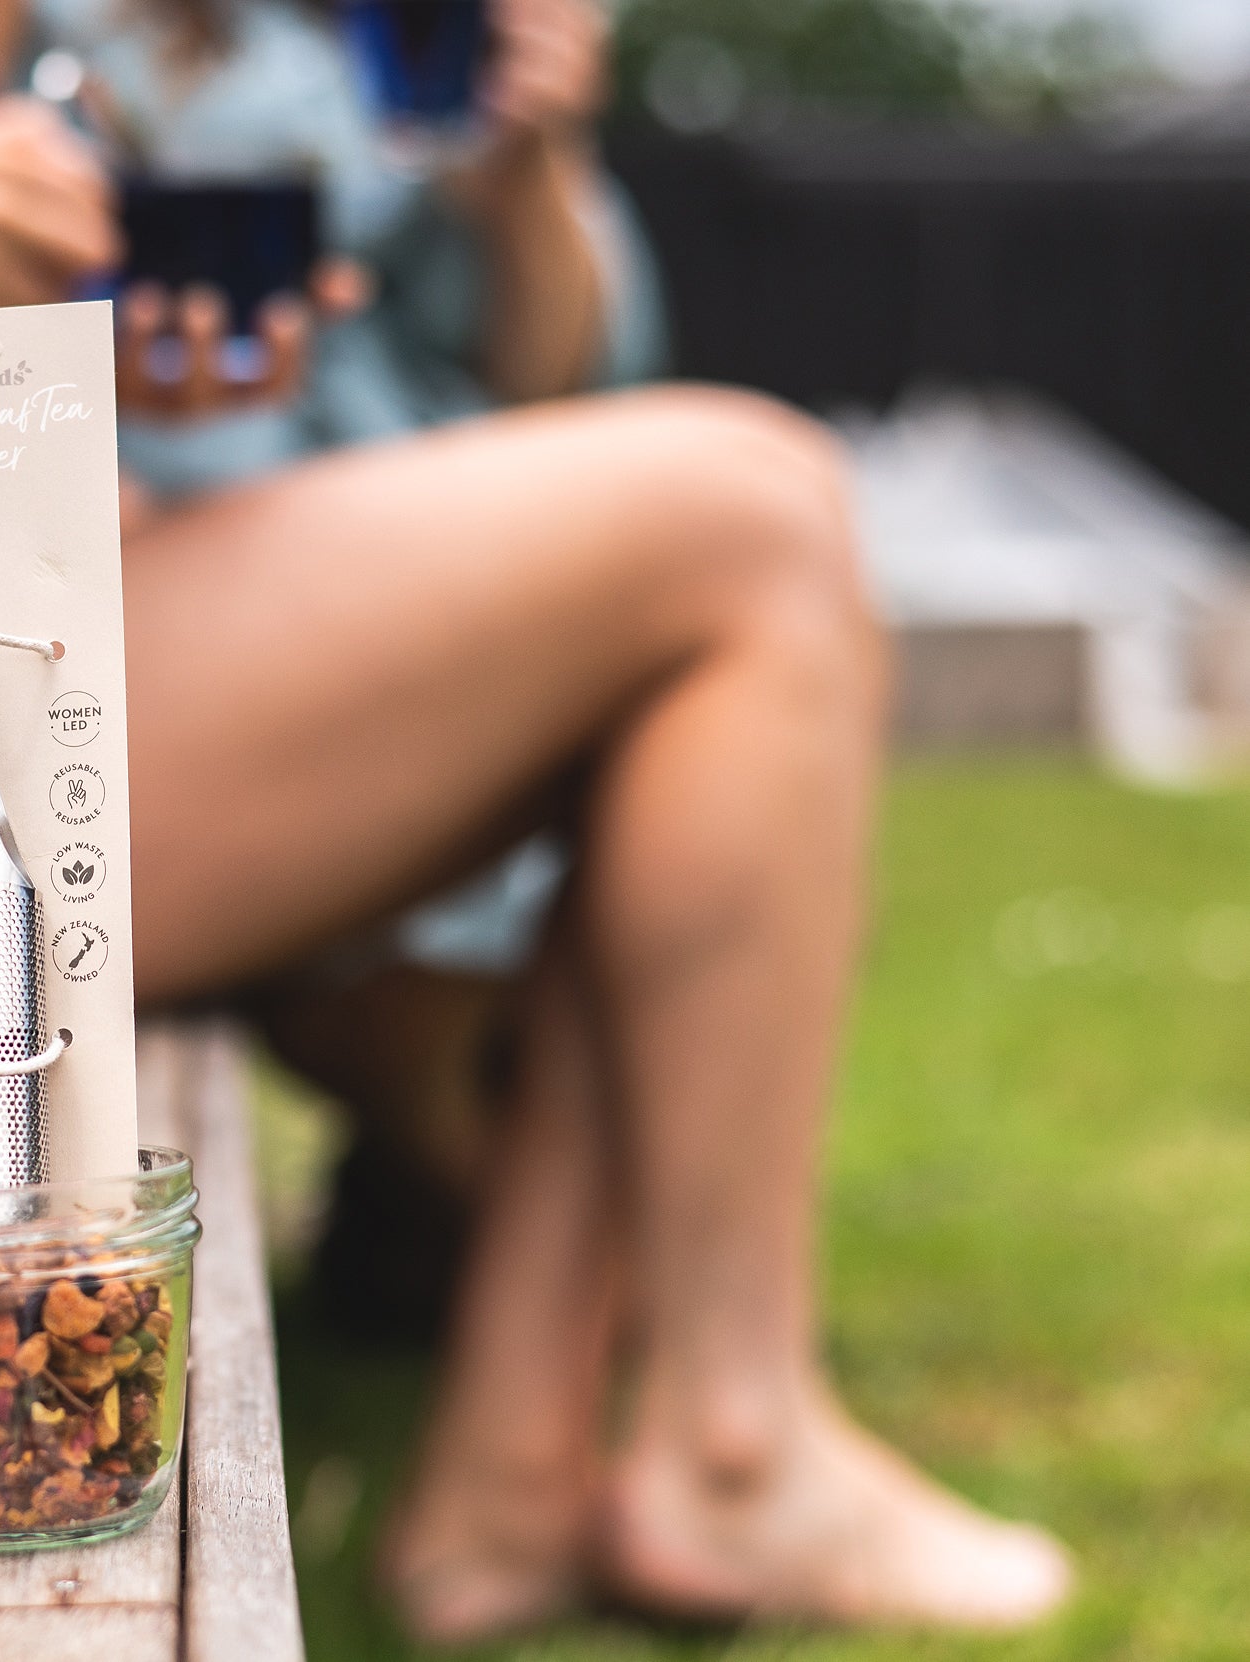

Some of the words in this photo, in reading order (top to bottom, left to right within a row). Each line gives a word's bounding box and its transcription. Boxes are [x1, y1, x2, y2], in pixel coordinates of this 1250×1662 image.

[31, 383, 93, 433] Tea
[48, 706, 101, 720] WOMEN
[63, 720, 87, 731] LED
[53, 763, 100, 780] REUSABLE
[55, 808, 101, 825] REUSABLE
[52, 844, 71, 862] LOW
[75, 842, 104, 859] WASTE
[62, 892, 95, 904] LIVING
[51, 926, 67, 947] NEW
[70, 920, 109, 943] ZEALAND
[63, 970, 98, 982] OWNED
